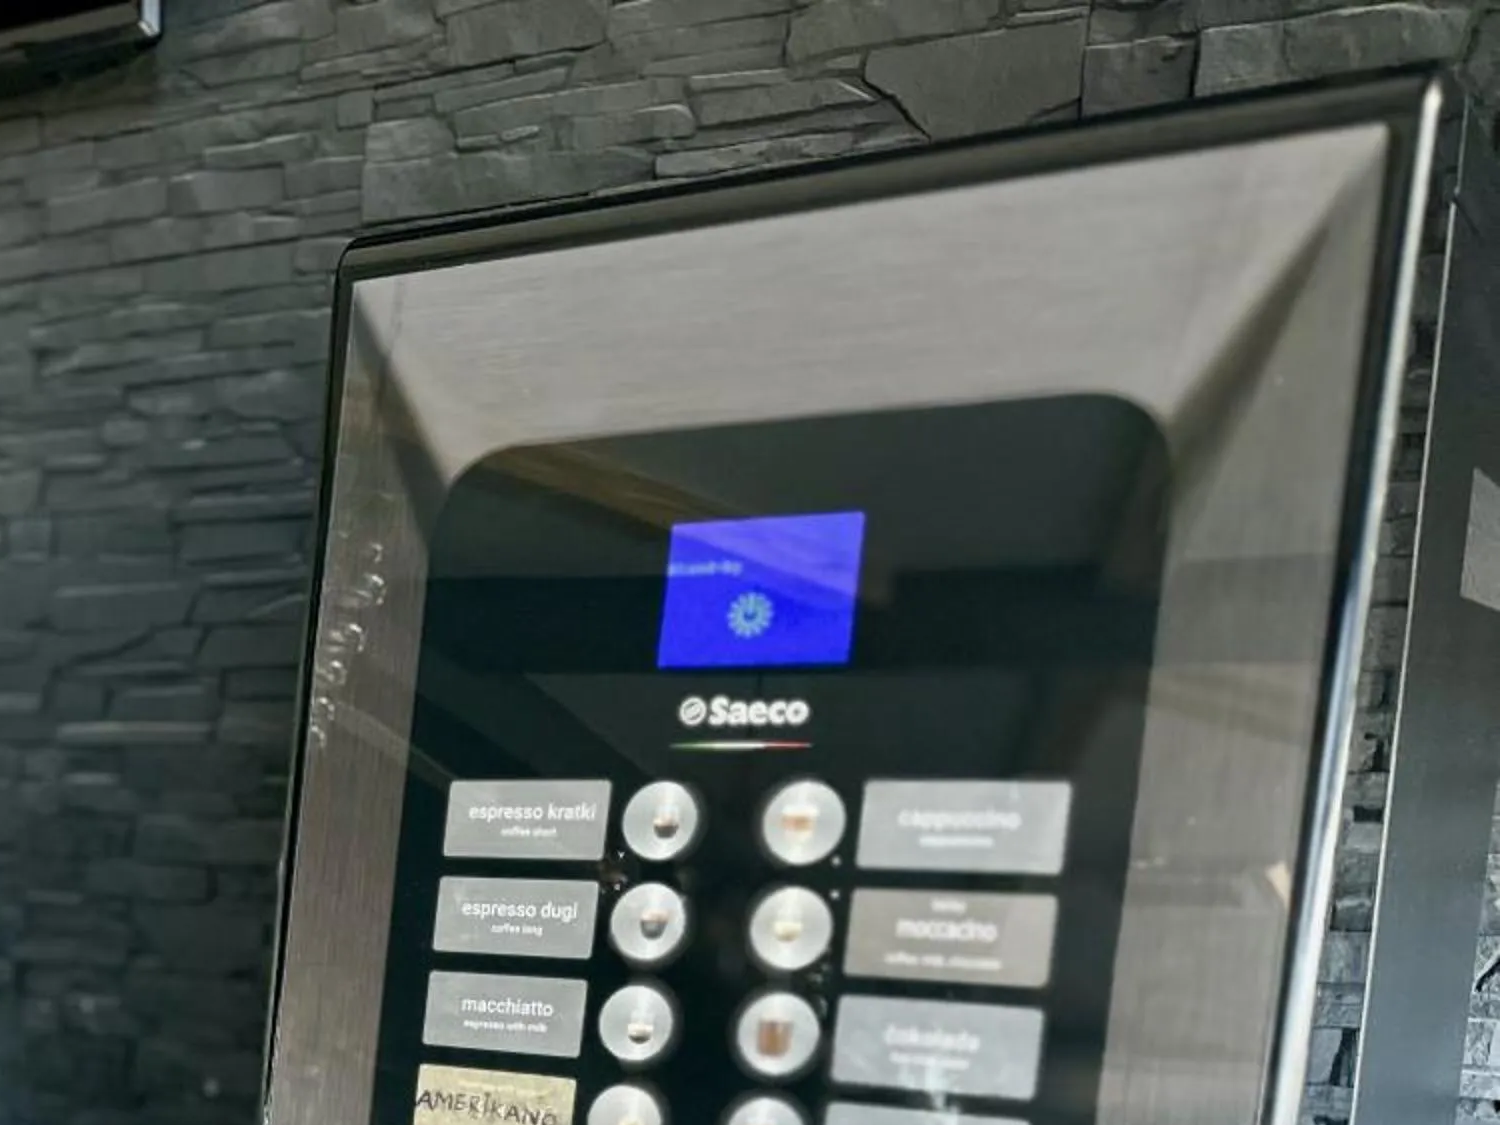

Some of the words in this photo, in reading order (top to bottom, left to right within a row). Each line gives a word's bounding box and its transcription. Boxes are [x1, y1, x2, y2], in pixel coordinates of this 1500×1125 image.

[708, 695, 810, 726] Saeco
[468, 804, 543, 823] espresso
[547, 800, 598, 821] kratki
[461, 901, 536, 919] espresso
[540, 901, 578, 922] dugi
[461, 997, 554, 1017] macchiatto
